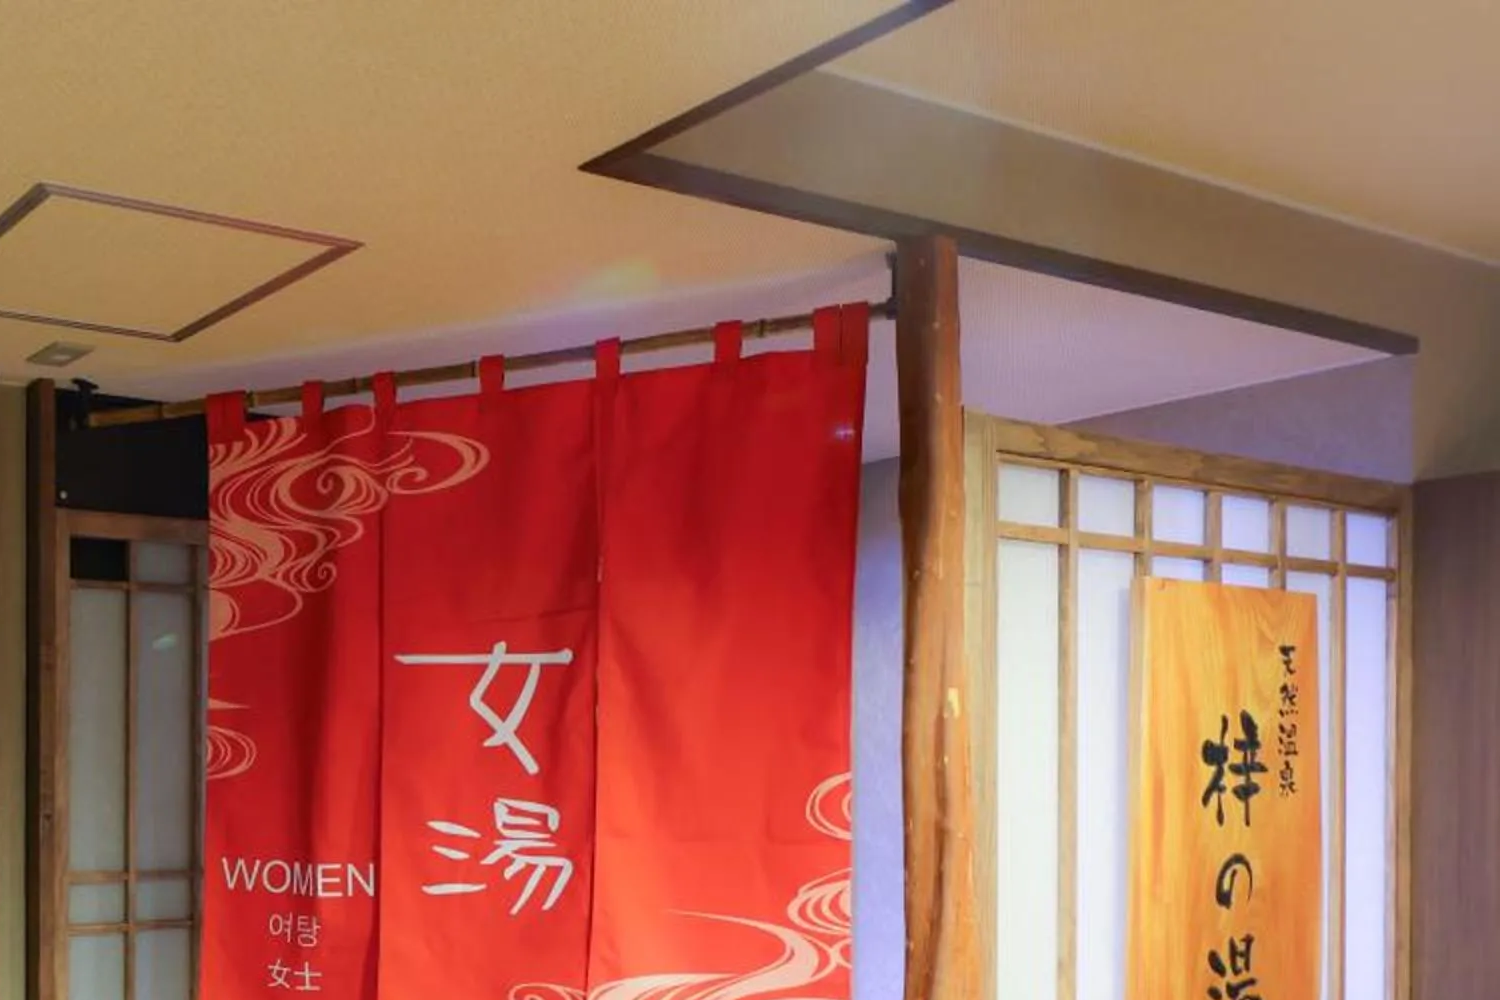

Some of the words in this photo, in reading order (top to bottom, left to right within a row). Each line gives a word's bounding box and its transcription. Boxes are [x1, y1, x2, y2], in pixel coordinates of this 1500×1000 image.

[393, 640, 575, 916] 女湯
[221, 856, 376, 898] WOMEN
[268, 911, 322, 948] 여탕
[267, 957, 323, 992] 女士
